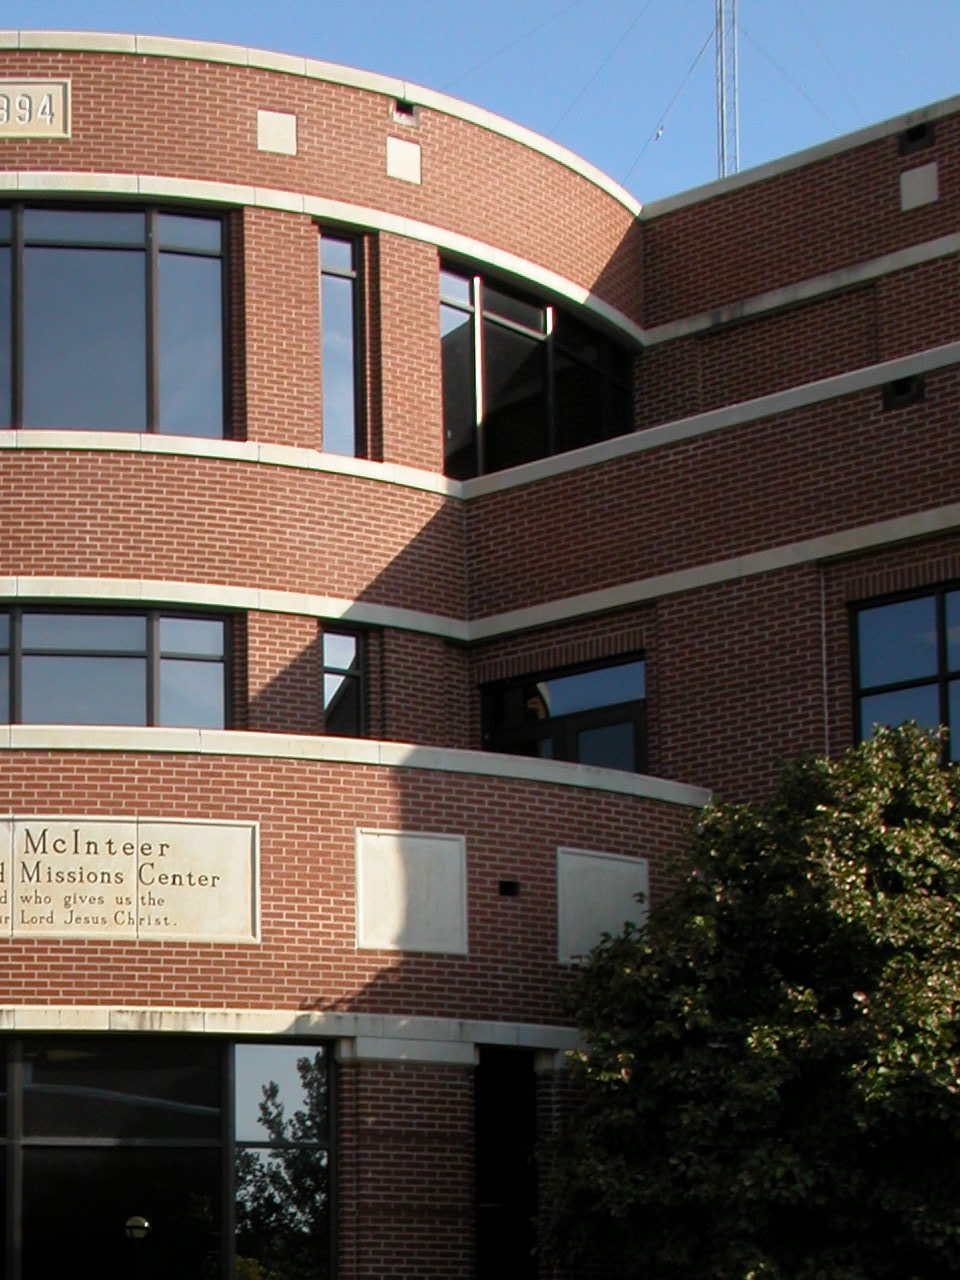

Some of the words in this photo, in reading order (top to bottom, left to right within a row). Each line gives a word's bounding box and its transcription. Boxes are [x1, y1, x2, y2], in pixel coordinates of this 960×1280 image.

[24, 828, 170, 856] McInteer
[21, 861, 124, 885] Missions
[138, 864, 220, 888] Center
[20, 891, 52, 905] who
[64, 894, 104, 908] gives
[115, 895, 132, 906] us
[140, 893, 165, 907] the
[21, 911, 54, 925] Lord
[64, 911, 108, 926] Jesus
[114, 912, 177, 927] Christ.
